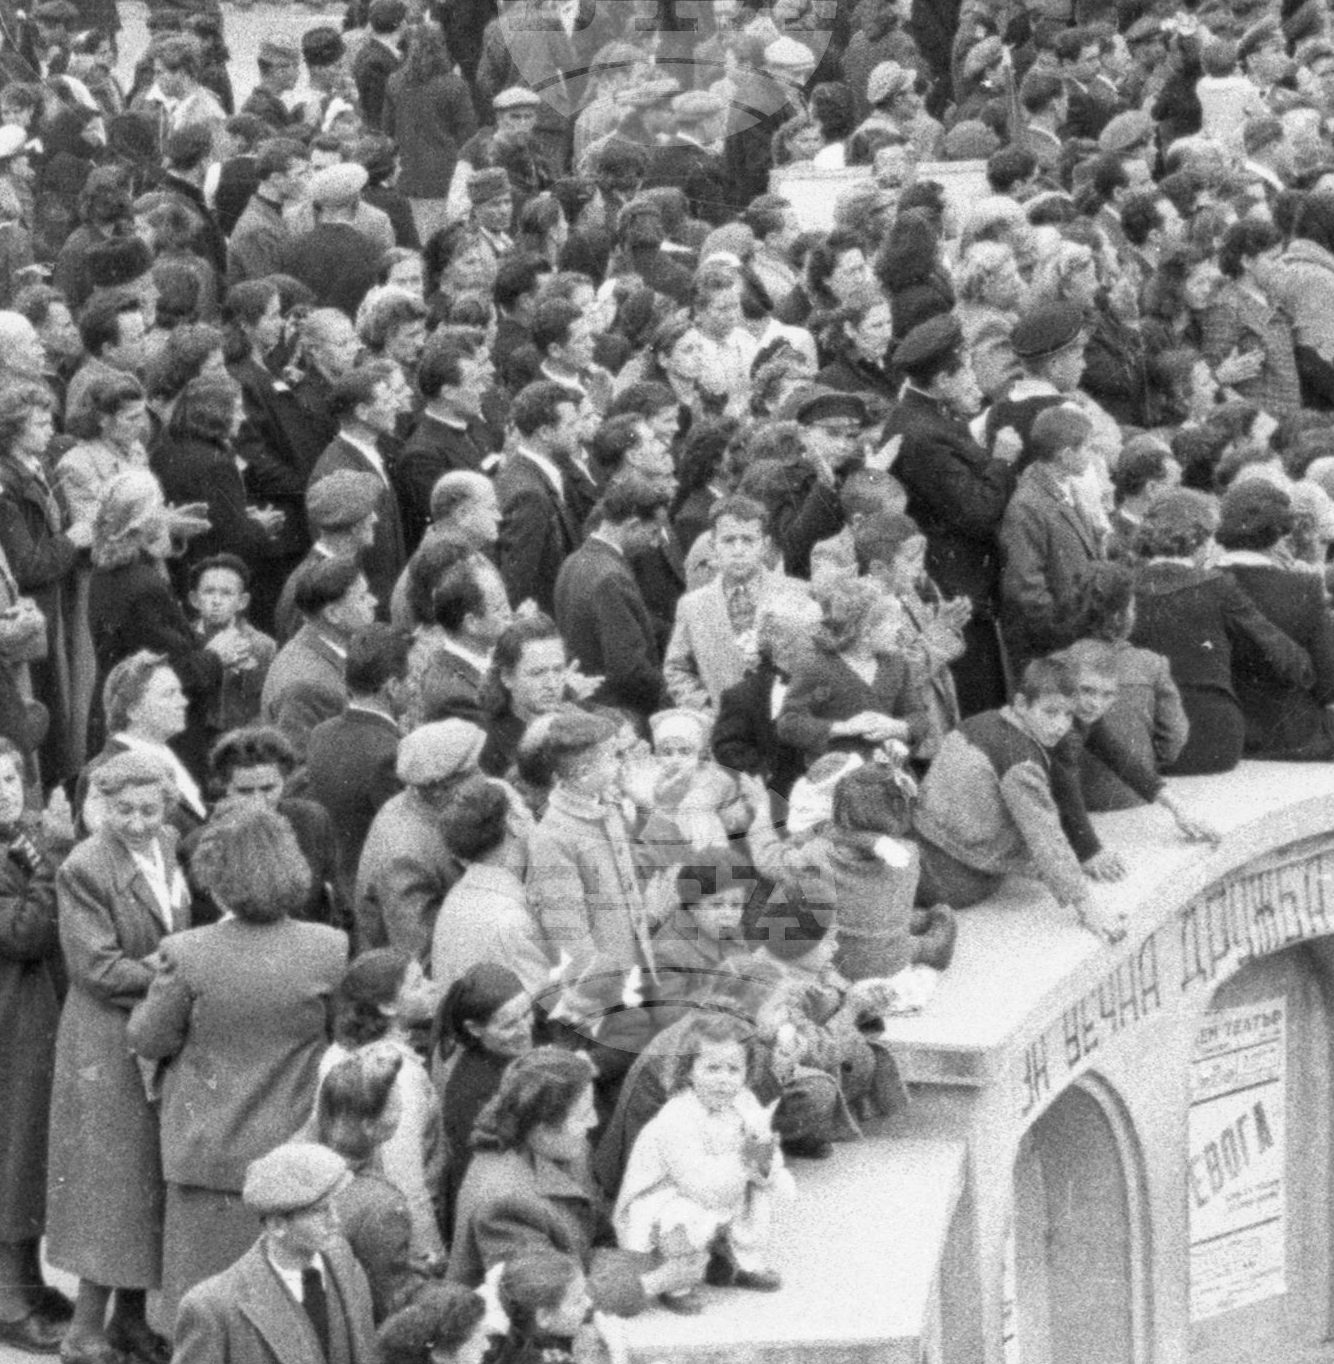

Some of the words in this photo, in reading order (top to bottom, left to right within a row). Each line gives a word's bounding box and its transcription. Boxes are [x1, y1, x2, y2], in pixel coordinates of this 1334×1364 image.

[1063, 934, 1162, 1068] ВЕЧНА
[1180, 854, 1331, 993] ДРУЖБА
[1223, 1008, 1283, 1038] ТЕАТЪР
[1190, 1099, 1275, 1210] ЕВОГА
